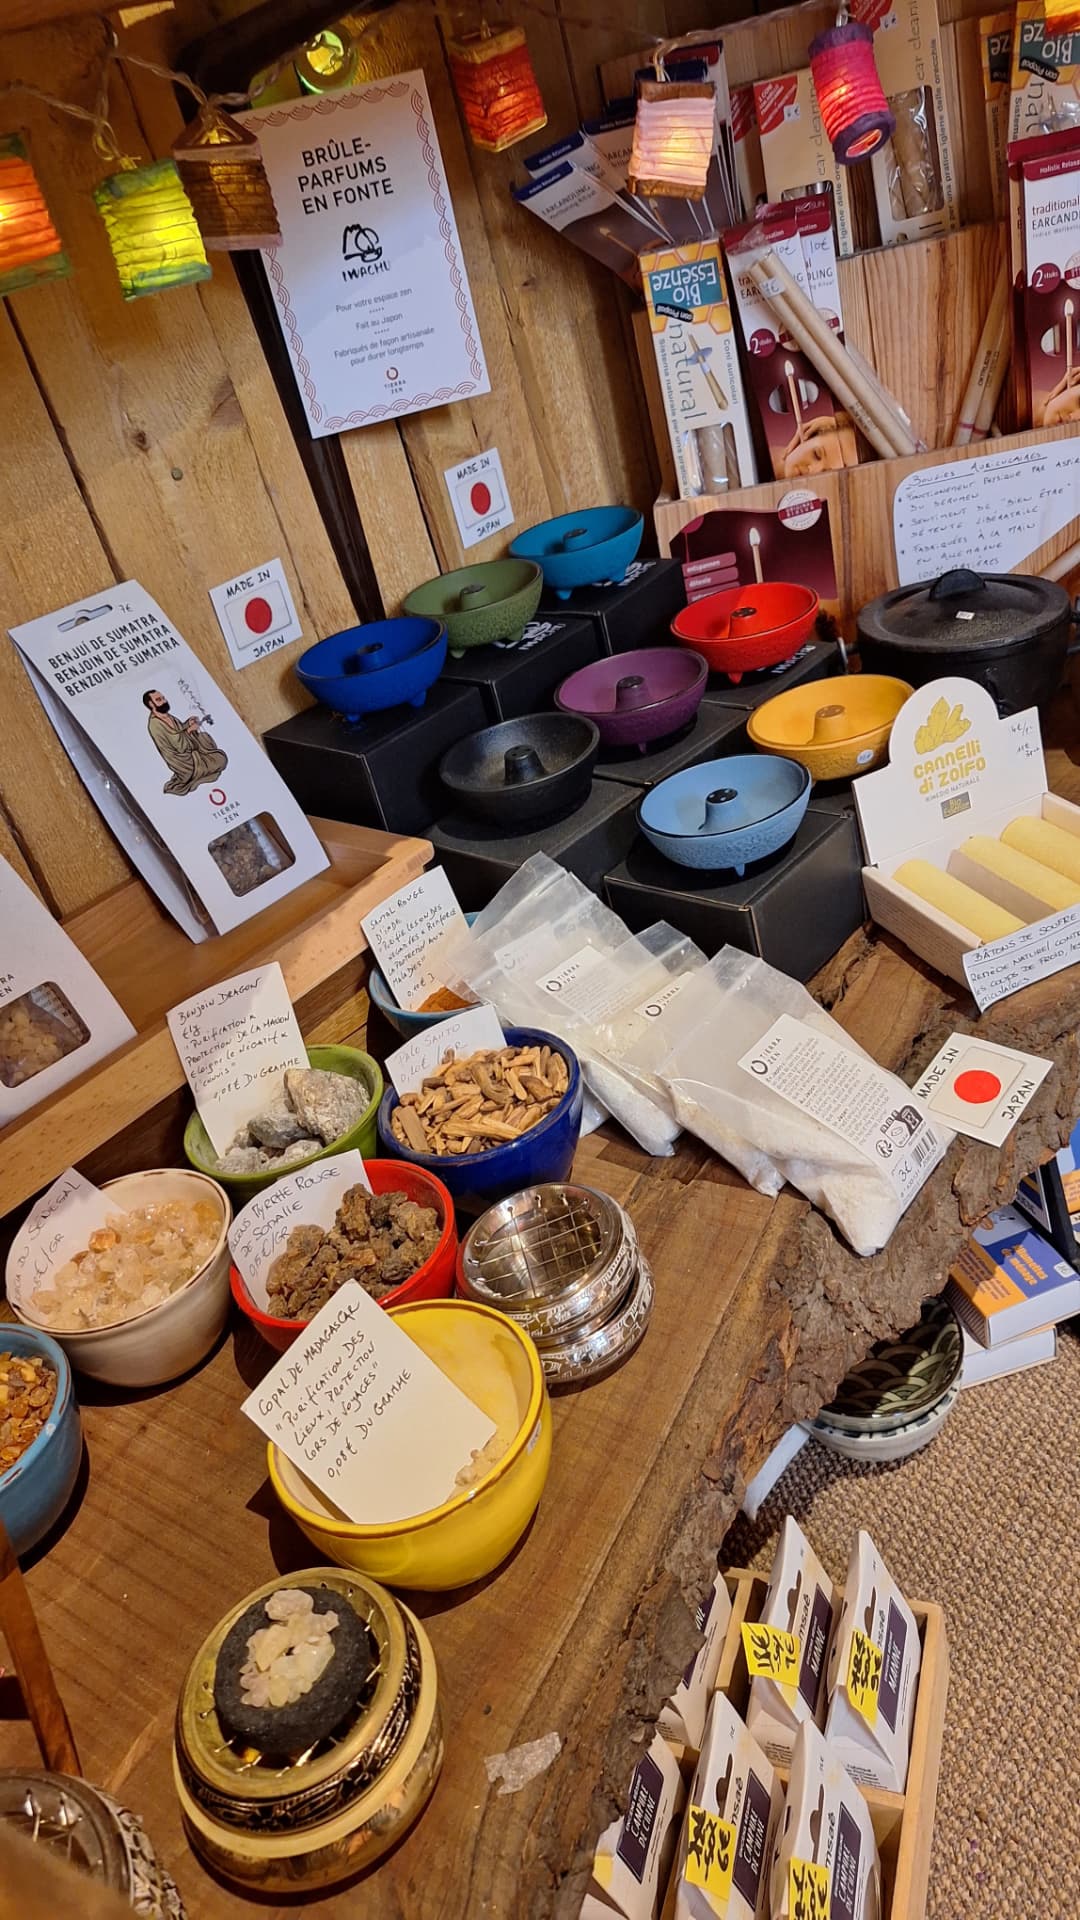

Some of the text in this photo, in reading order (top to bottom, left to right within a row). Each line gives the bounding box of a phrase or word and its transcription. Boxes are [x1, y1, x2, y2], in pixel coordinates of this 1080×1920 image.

[1042, 40, 1072, 64] Bio
[302, 138, 371, 166] BRÛLE-
[298, 156, 387, 192] PARFUMS
[302, 178, 394, 214] EN FONTE
[810, 238, 830, 253] 10€
[342, 261, 391, 282] IWACHU
[652, 261, 717, 291] Essenze
[1035, 269, 1044, 288] 2
[336, 288, 412, 313] Pour votre espace zen
[673, 285, 701, 305] Bio
[356, 313, 403, 330] Fait au Japon
[334, 327, 435, 359] Fabriqués de façon artisanale
[350, 340, 424, 367] pour durer longtemps
[751, 338, 761, 354] 2
[669, 323, 707, 419] natural
[457, 457, 490, 480] MADE IN
[1032, 465, 1045, 473] PAR
[477, 518, 501, 537] JAPAN
[911, 509, 967, 526] SENTIMENT
[990, 529, 1000, 538] LA
[1008, 522, 1036, 534] MAIN
[226, 569, 271, 599] MADE IN
[48, 613, 158, 669] BENJUÍ DE SUMATRA
[54, 624, 172, 684] BENJOIN DE SUMATRA
[253, 635, 285, 658] JAPAN
[64, 637, 181, 698] BENZOIN OF SUMATRA
[918, 778, 933, 795] di
[950, 775, 980, 793] NATURALE
[212, 801, 241, 820] TIERRA
[225, 811, 240, 825] ZEN
[397, 886, 425, 907] ROUGE
[974, 913, 1079, 962] BÂTONS DE SOUFRE
[556, 963, 580, 981] TIERRA
[218, 976, 264, 1006] DRAGON
[759, 1037, 782, 1059] TIERRA
[767, 1052, 781, 1065] ZEN
[259, 1057, 301, 1078] GRAMME
[917, 1048, 960, 1100] MADE IN
[1001, 1080, 1035, 1120] JAPAN
[898, 1160, 913, 1182] 3€
[342, 1330, 366, 1359] DES
[325, 1341, 376, 1403] PROTECTION
[258, 1377, 290, 1417] COPAL
[293, 1364, 304, 1386] DE
[355, 1417, 374, 1440] DU
[374, 1368, 412, 1417] GRAMME
[304, 1437, 327, 1461] LORS
[326, 1419, 342, 1436] DE
[809, 1626, 826, 1677] MANNE
[870, 1656, 882, 1692] 9€
[887, 1641, 904, 1694] MANNE
[631, 1785, 649, 1837] CAMPHRE
[639, 1796, 656, 1848] DE CHINE
[717, 1828, 731, 1872] 6€
[743, 1807, 759, 1864] CAMPHRE
[751, 1820, 765, 1875] DE CHINE
[839, 1843, 851, 1903] CAMPHRE
